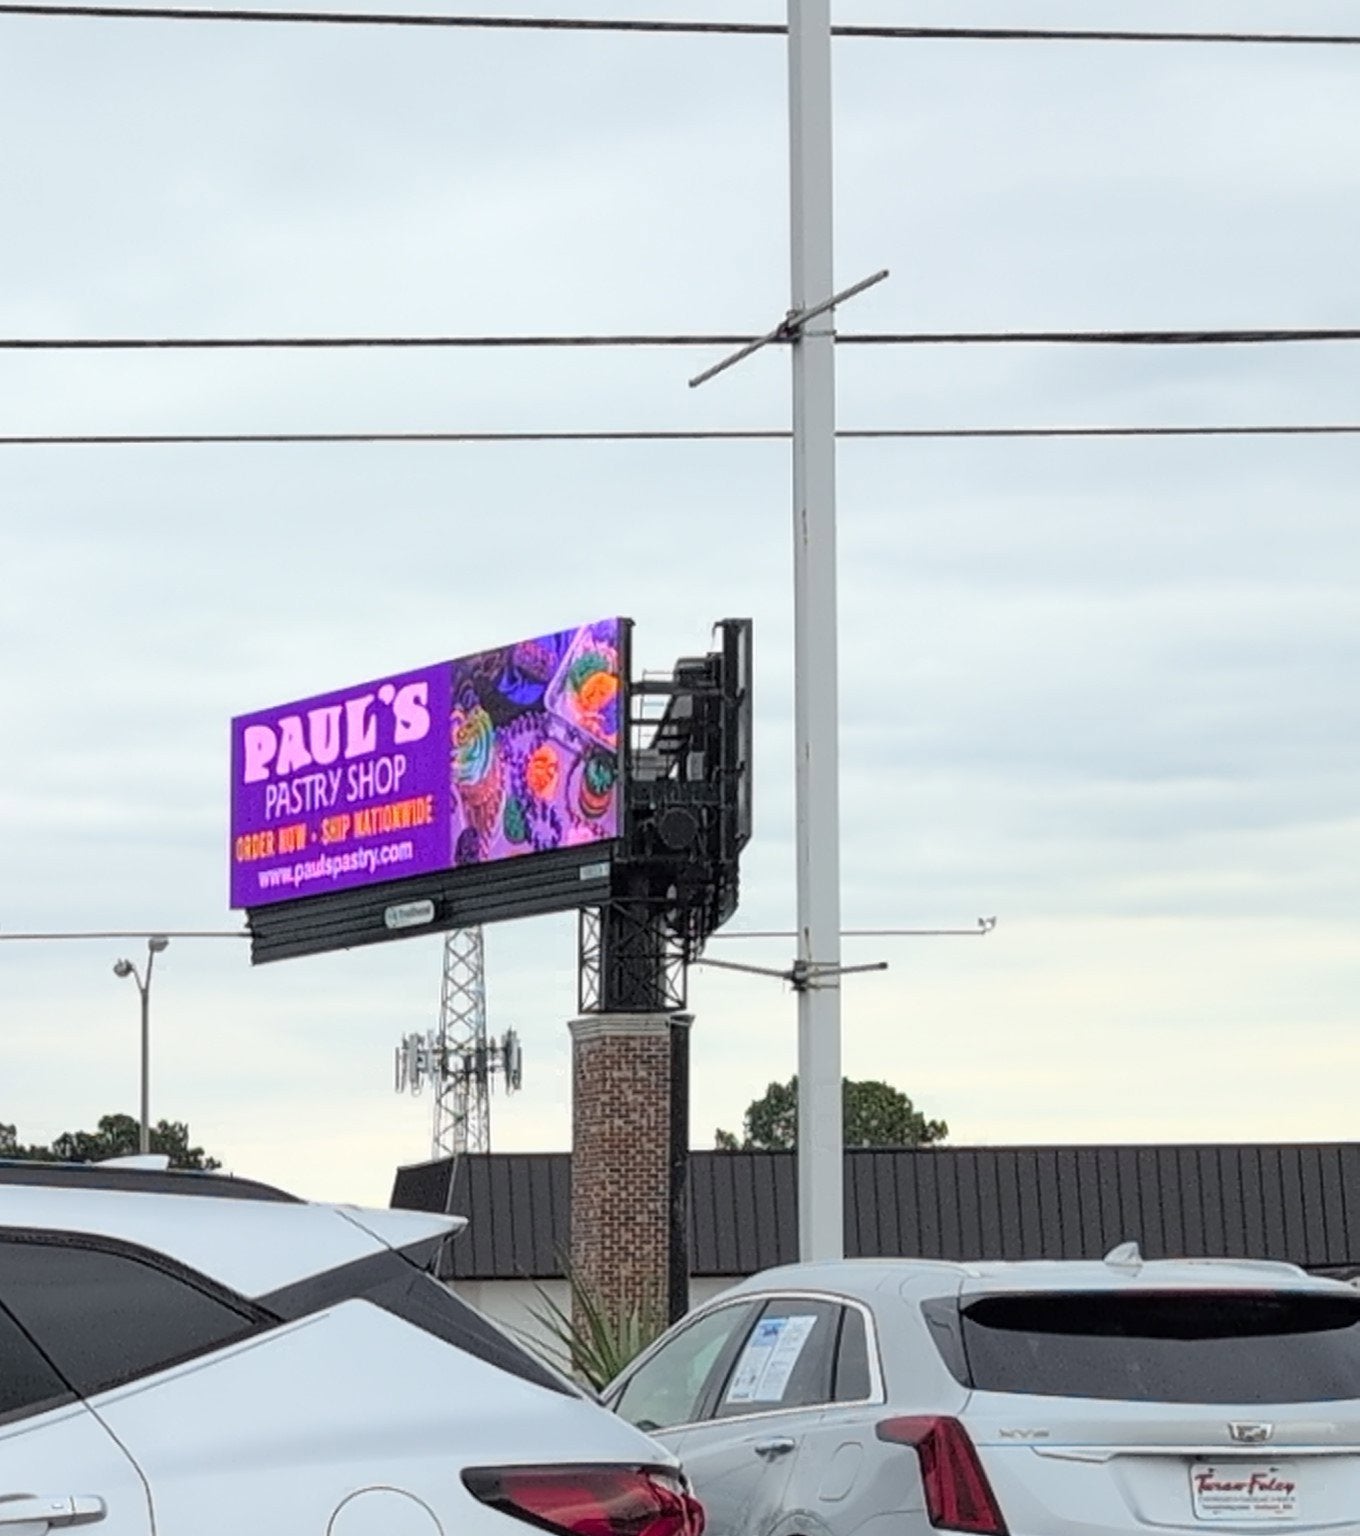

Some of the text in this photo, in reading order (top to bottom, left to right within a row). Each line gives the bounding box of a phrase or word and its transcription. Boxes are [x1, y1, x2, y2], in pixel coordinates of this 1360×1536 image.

[243, 681, 431, 785] PAUL'S
[265, 753, 407, 821] PASTRY SHOP
[235, 829, 276, 863] ORDER
